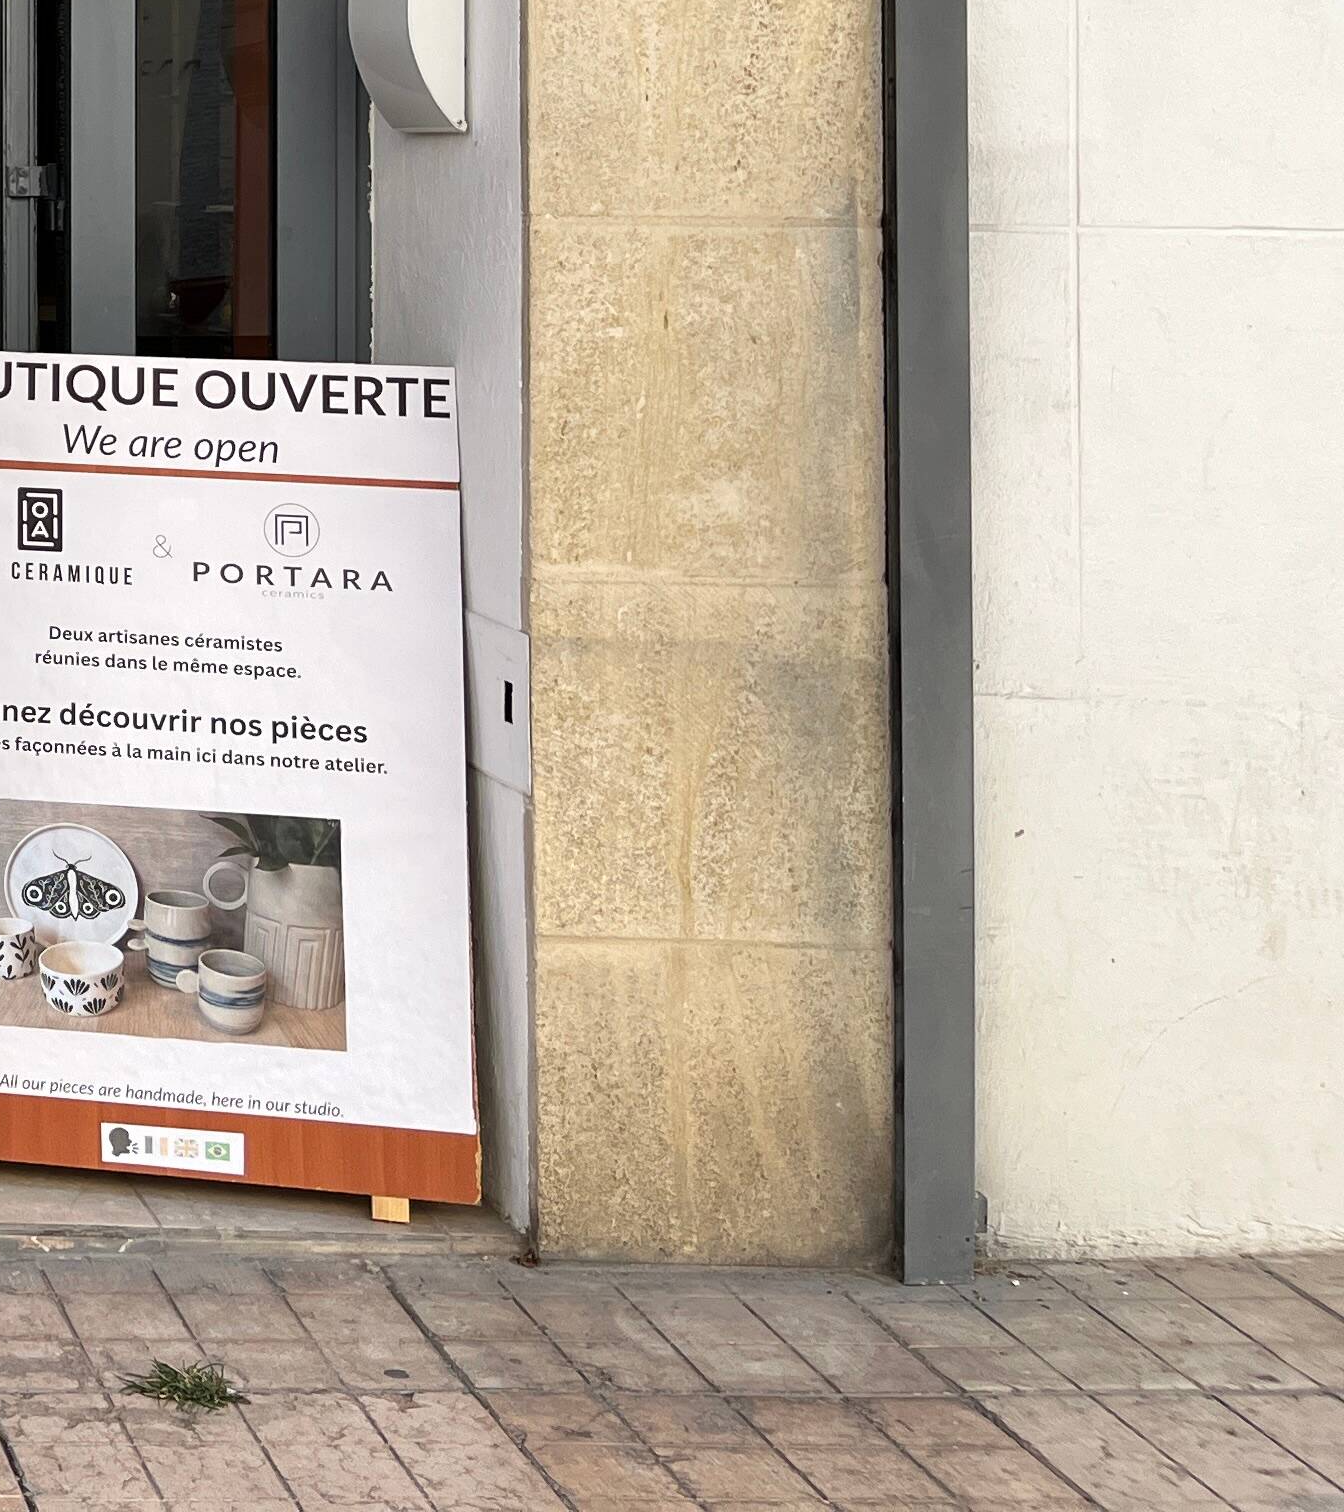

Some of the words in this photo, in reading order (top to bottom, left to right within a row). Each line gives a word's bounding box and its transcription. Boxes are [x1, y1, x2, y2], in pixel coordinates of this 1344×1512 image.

[195, 369, 451, 419] OUVERTE
[63, 423, 117, 455] We
[128, 435, 182, 459] are
[194, 438, 279, 467] open
[11, 562, 132, 585] CERAMIQUE
[153, 535, 173, 558] &
[193, 562, 393, 592] PORTARA
[262, 590, 324, 599] ceramics
[49, 626, 93, 642] Deux
[98, 629, 179, 646] artisanes
[185, 633, 282, 652] céramistes
[35, 650, 99, 667] réunies
[105, 654, 147, 670] dans
[153, 656, 167, 671] le
[173, 658, 228, 674] même
[234, 665, 301, 680] espace.
[60, 702, 202, 732] découvrir
[211, 717, 262, 736] nos
[272, 715, 367, 744] pièces
[15, 736, 106, 759] façonnées
[112, 742, 122, 757] à
[127, 743, 142, 758] la
[148, 746, 191, 762] main
[197, 748, 216, 763] ici
[222, 750, 265, 766] dans
[271, 756, 319, 769] notre
[325, 758, 387, 774] atelier.
[0, 1074, 18, 1088] All
[22, 1080, 46, 1090] our
[50, 1079, 94, 1095] pieces
[99, 1086, 121, 1097] are
[126, 1084, 206, 1106] handmade,
[212, 1092, 243, 1108] here
[248, 1095, 260, 1110] in
[266, 1101, 290, 1112] our
[294, 1101, 343, 1117] studio.
